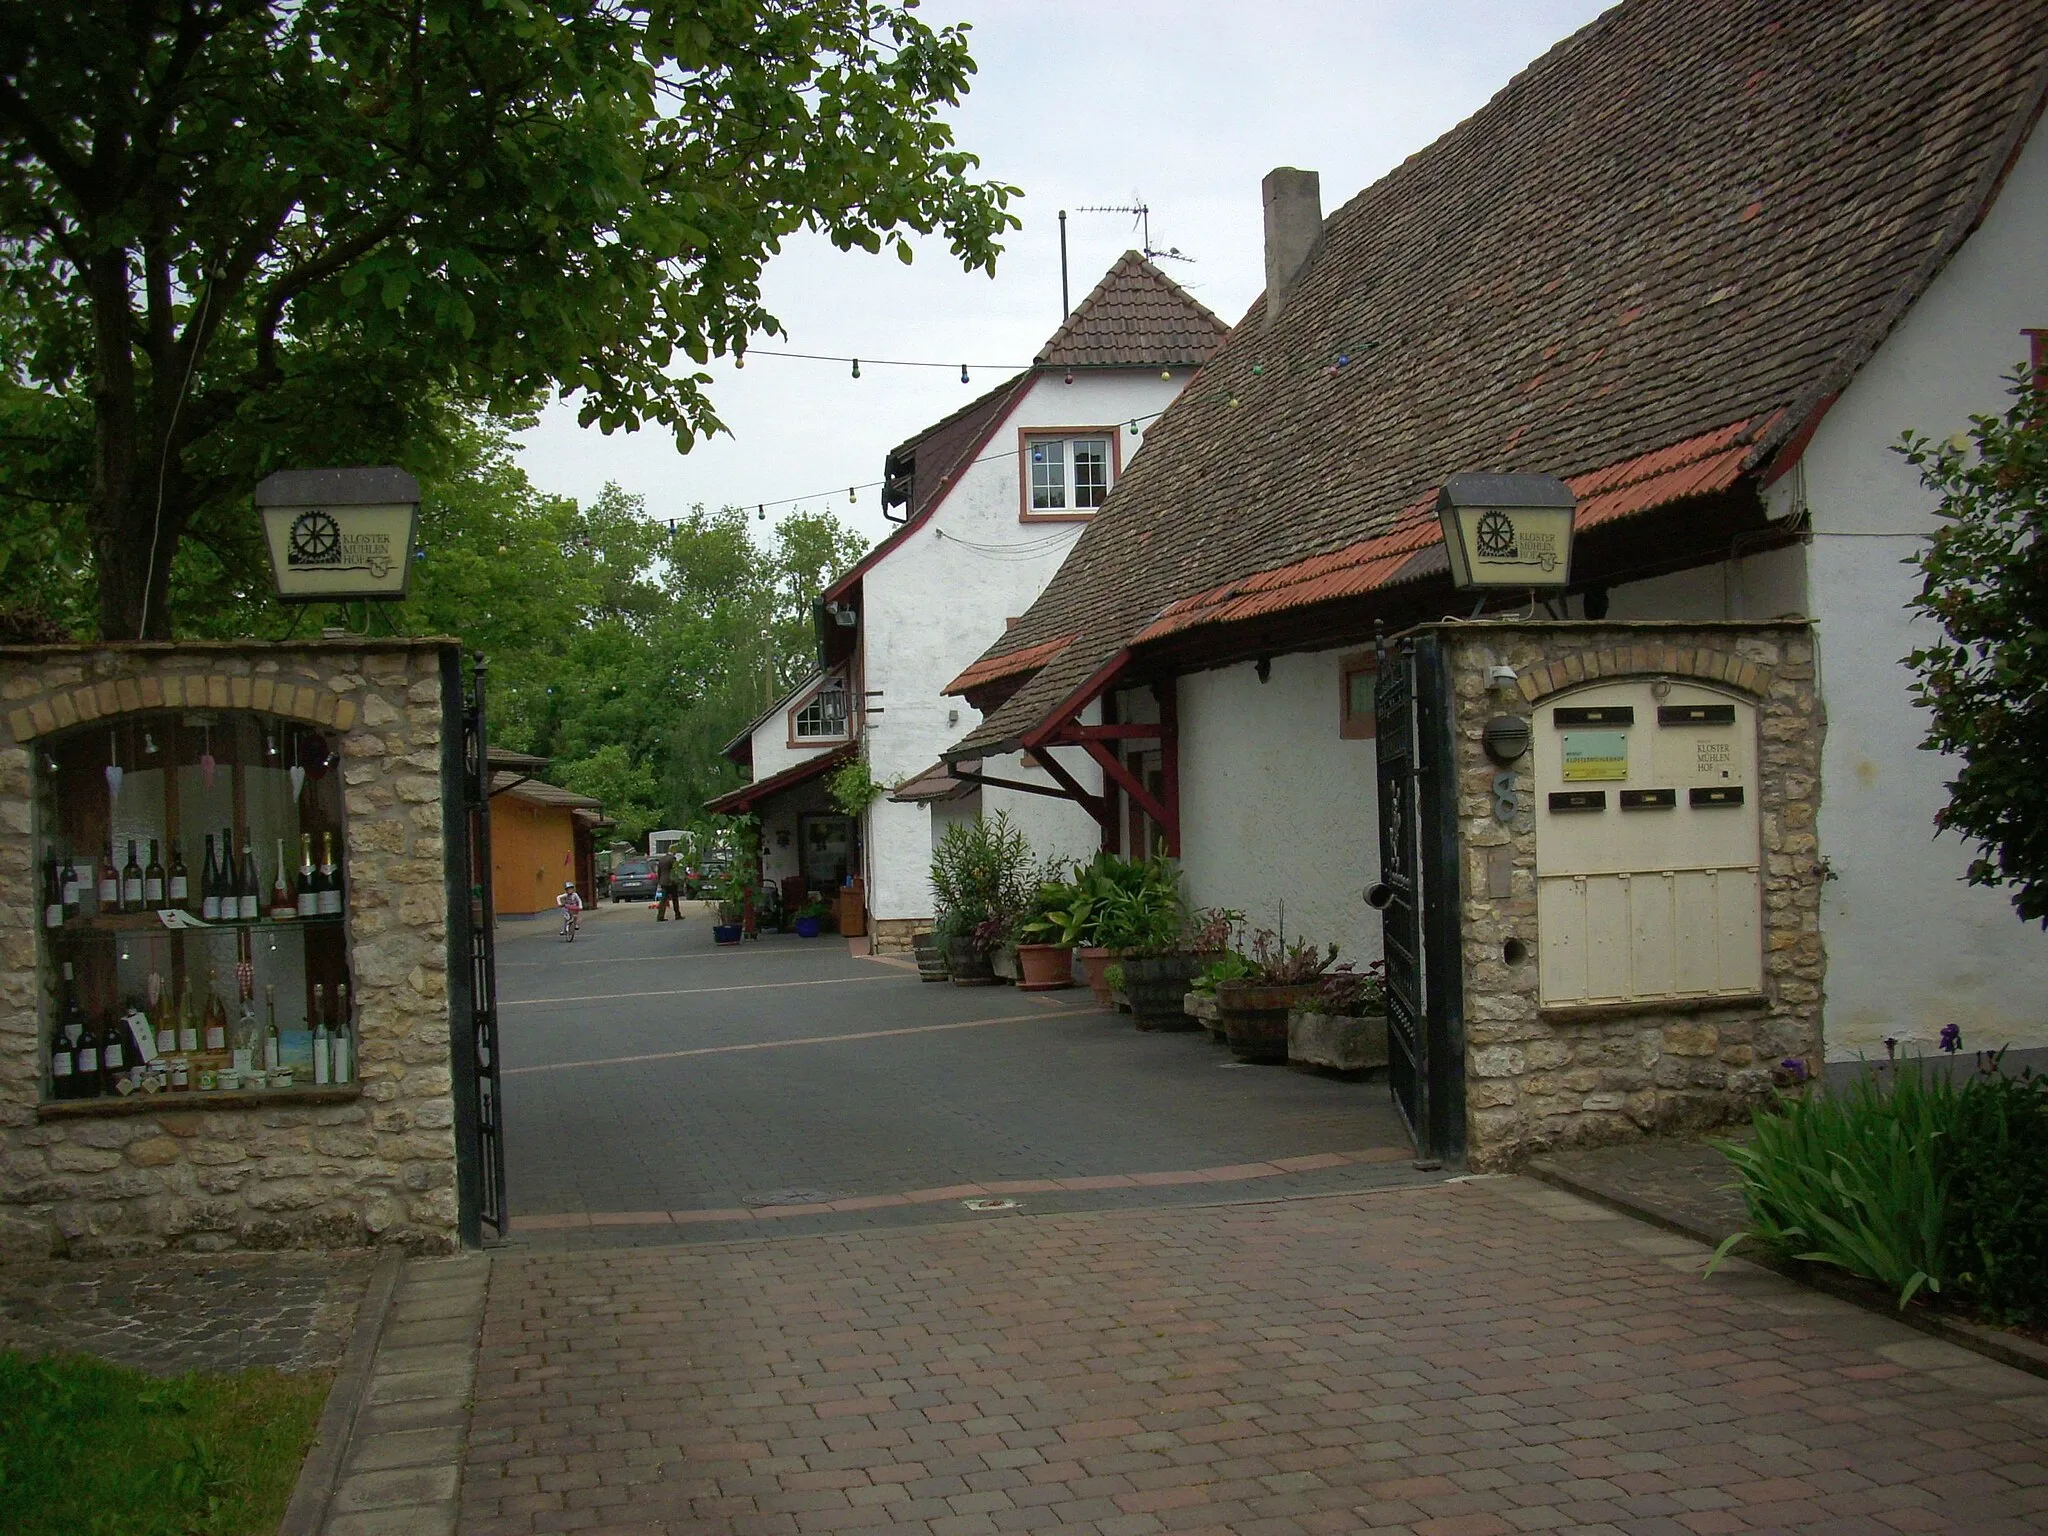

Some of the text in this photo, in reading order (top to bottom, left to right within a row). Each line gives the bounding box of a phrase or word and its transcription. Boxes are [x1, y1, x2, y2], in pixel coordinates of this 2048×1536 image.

[343, 534, 390, 544] KLOSTER
[1520, 532, 1555, 542] KLOSTER
[1697, 743, 1730, 753] KLOSTER
[1697, 763, 1713, 772] HOF
[1493, 770, 1519, 822] 8
